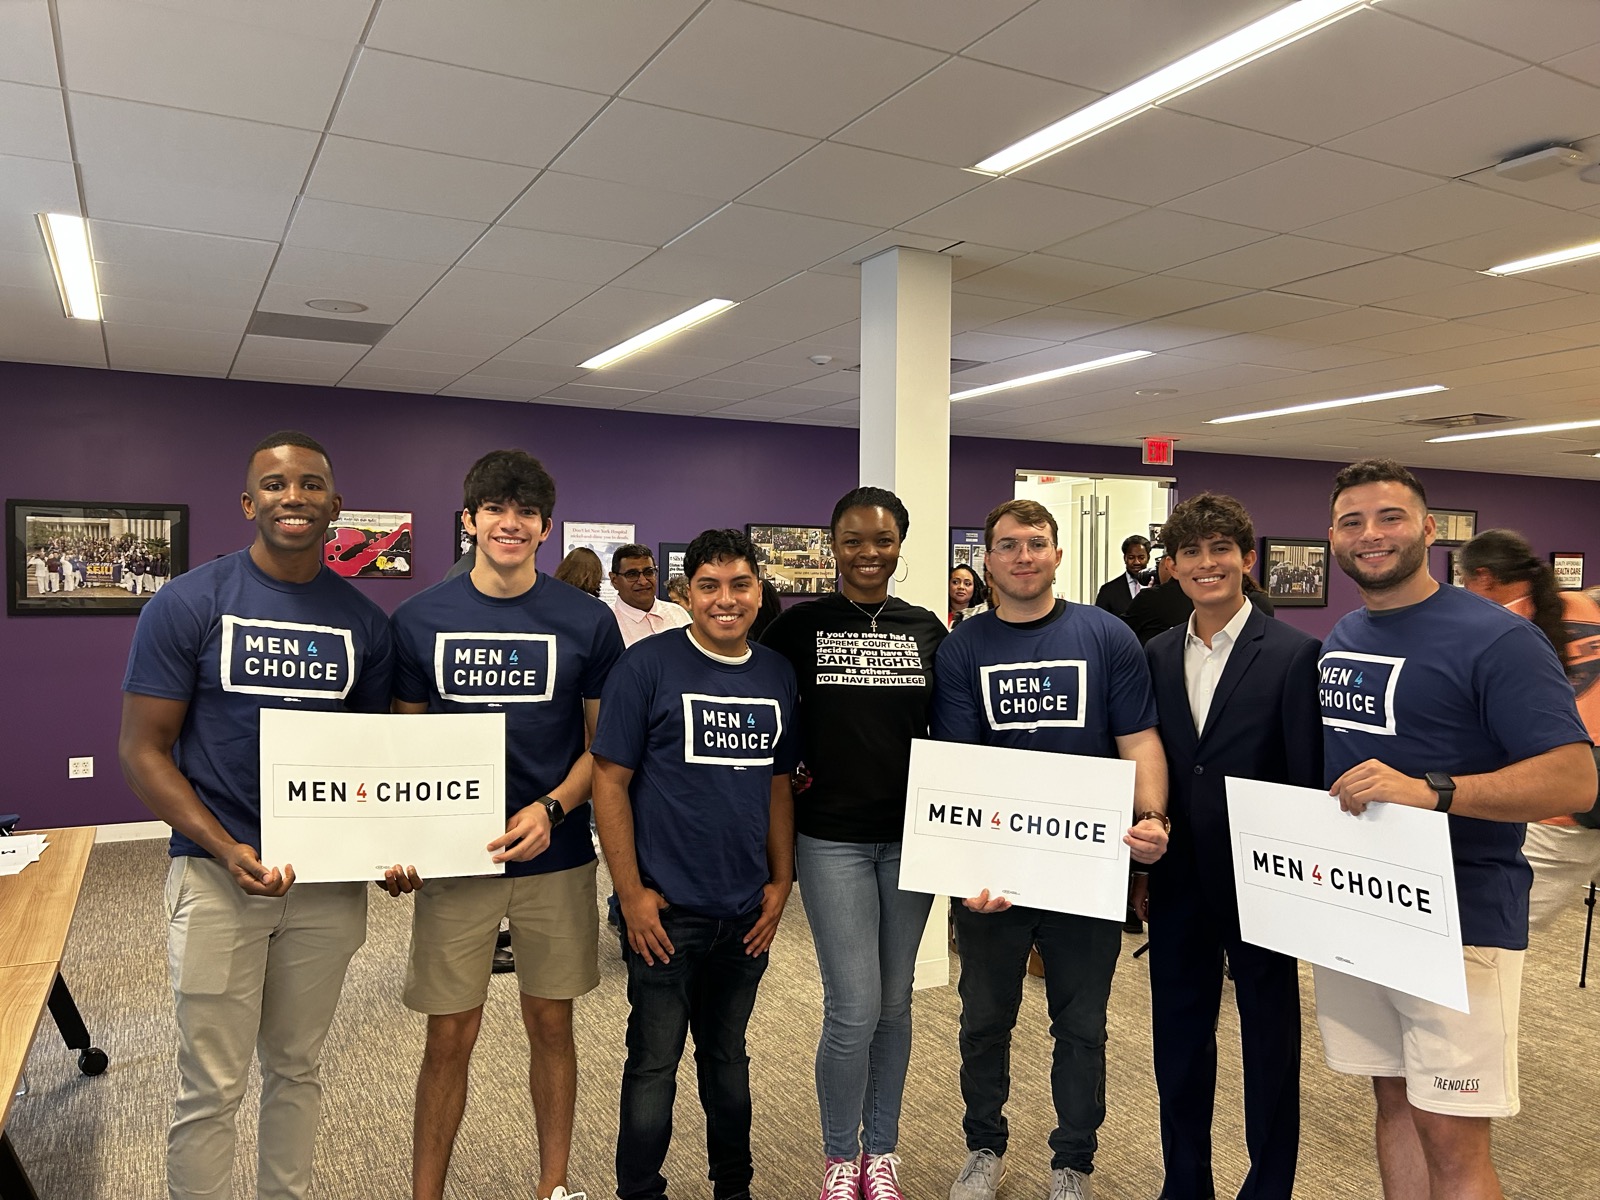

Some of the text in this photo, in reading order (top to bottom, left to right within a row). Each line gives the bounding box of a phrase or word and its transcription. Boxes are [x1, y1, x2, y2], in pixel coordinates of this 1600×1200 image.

[1147, 441, 1168, 463] EXIT
[245, 634, 318, 656] MEN 4
[817, 639, 859, 647] SUPREME
[827, 631, 859, 639] you've
[889, 633, 906, 641] had
[454, 648, 519, 665] MEN 4
[818, 655, 921, 667] SAME RIGHTS
[245, 657, 338, 681] CHOICE
[453, 669, 536, 687] CHOICE
[1321, 667, 1363, 688] MEN 4
[818, 675, 925, 685] YOU HAVE PRIVILEGE
[999, 676, 1051, 694] MEN 4
[1320, 689, 1375, 714] CHOICE
[702, 709, 755, 728] MEN 4
[704, 731, 770, 749] CHOICE
[288, 780, 480, 802] MEN 4 CHOICE
[928, 803, 1107, 843] MEN 4 CHOICE
[1253, 850, 1432, 914] MEN 4 CHOICE
[1433, 1076, 1480, 1091] TRENDLESS
